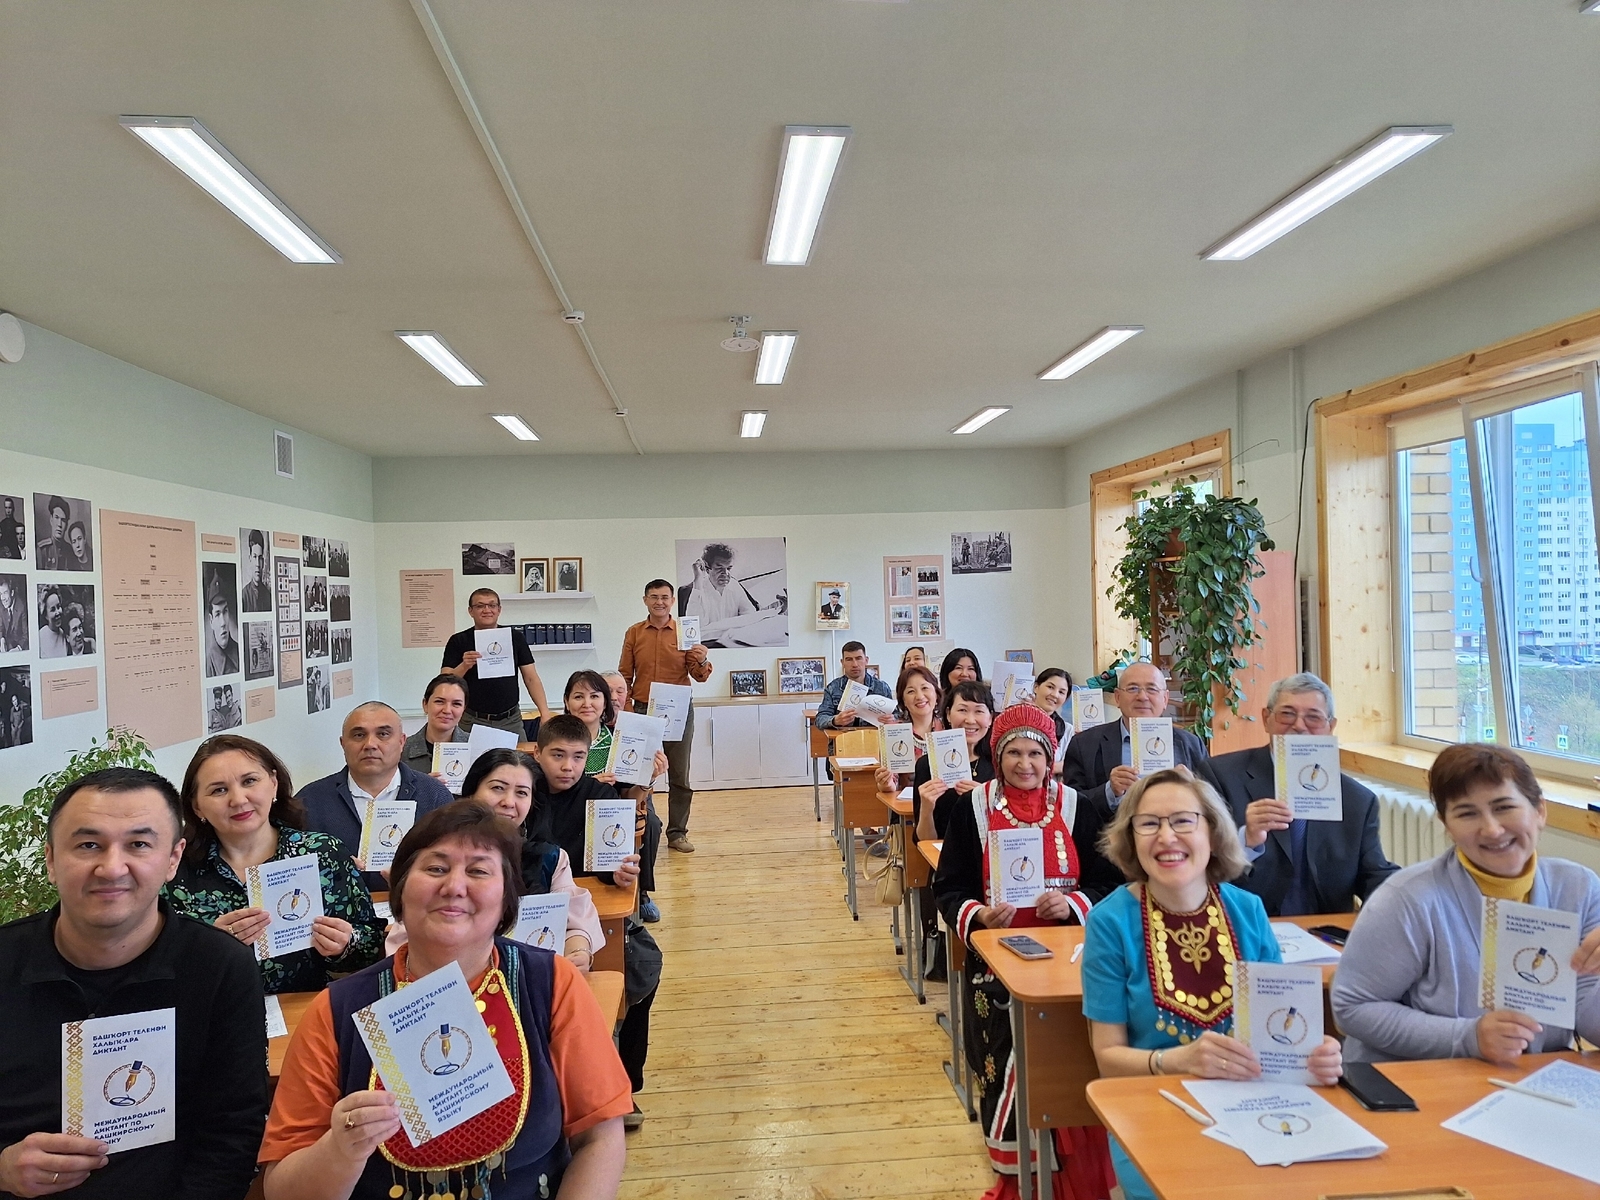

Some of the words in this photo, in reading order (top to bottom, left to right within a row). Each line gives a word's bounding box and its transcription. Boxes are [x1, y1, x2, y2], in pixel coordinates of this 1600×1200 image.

[388, 996, 425, 1020] БАШҠОРТ
[425, 979, 458, 1000] ТЕЛЕНӘН
[391, 1001, 436, 1027] ХАЛЫҠ-АРА
[395, 1012, 427, 1034] ДИКТАНТ
[92, 1030, 132, 1041] БАШҠОРТ
[133, 1025, 167, 1035] ТЕЛЕНӘН
[92, 1037, 139, 1049] ХАЛЫҠ-АРА
[92, 1045, 128, 1056] ДИКТАНТ
[428, 1062, 494, 1104] МЕЖДУНАРОДНЫЙ
[432, 1089, 463, 1111] ДИКТАНТ
[464, 1082, 475, 1092] ПО
[434, 1082, 490, 1117] БАШКИРСКОМУ
[94, 1107, 166, 1128] МЕЖДУНАРОДНЫЙ
[437, 1106, 462, 1123] ЯЗЫКУ
[93, 1122, 129, 1135] ДИКТАНТ
